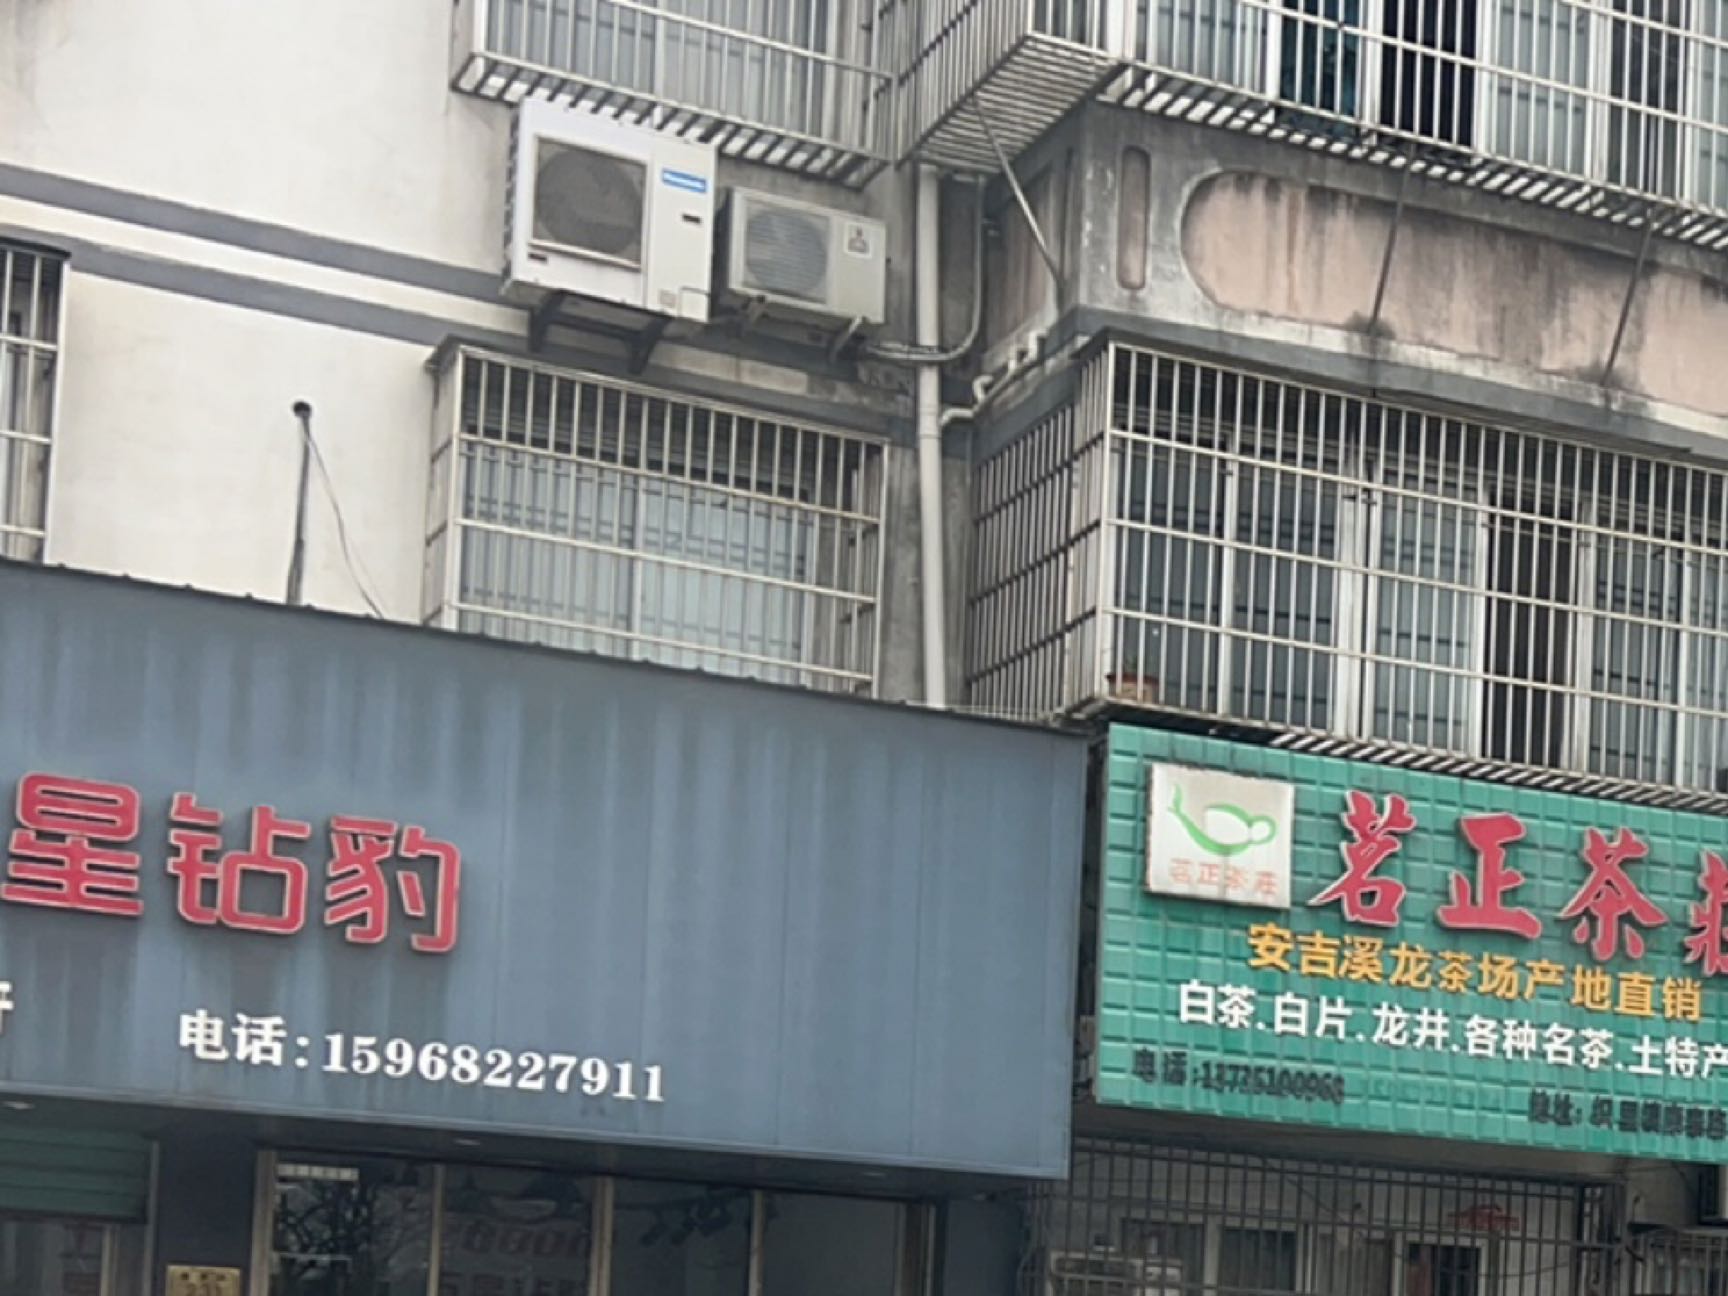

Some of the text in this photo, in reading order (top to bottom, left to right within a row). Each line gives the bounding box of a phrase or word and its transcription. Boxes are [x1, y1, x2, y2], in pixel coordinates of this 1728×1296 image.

[1, 771, 461, 953] 星钻豹
[1247, 922, 1703, 1023] 安吉溪龙茶场产地直销
[178, 1008, 665, 1102] 电话:15968227911
